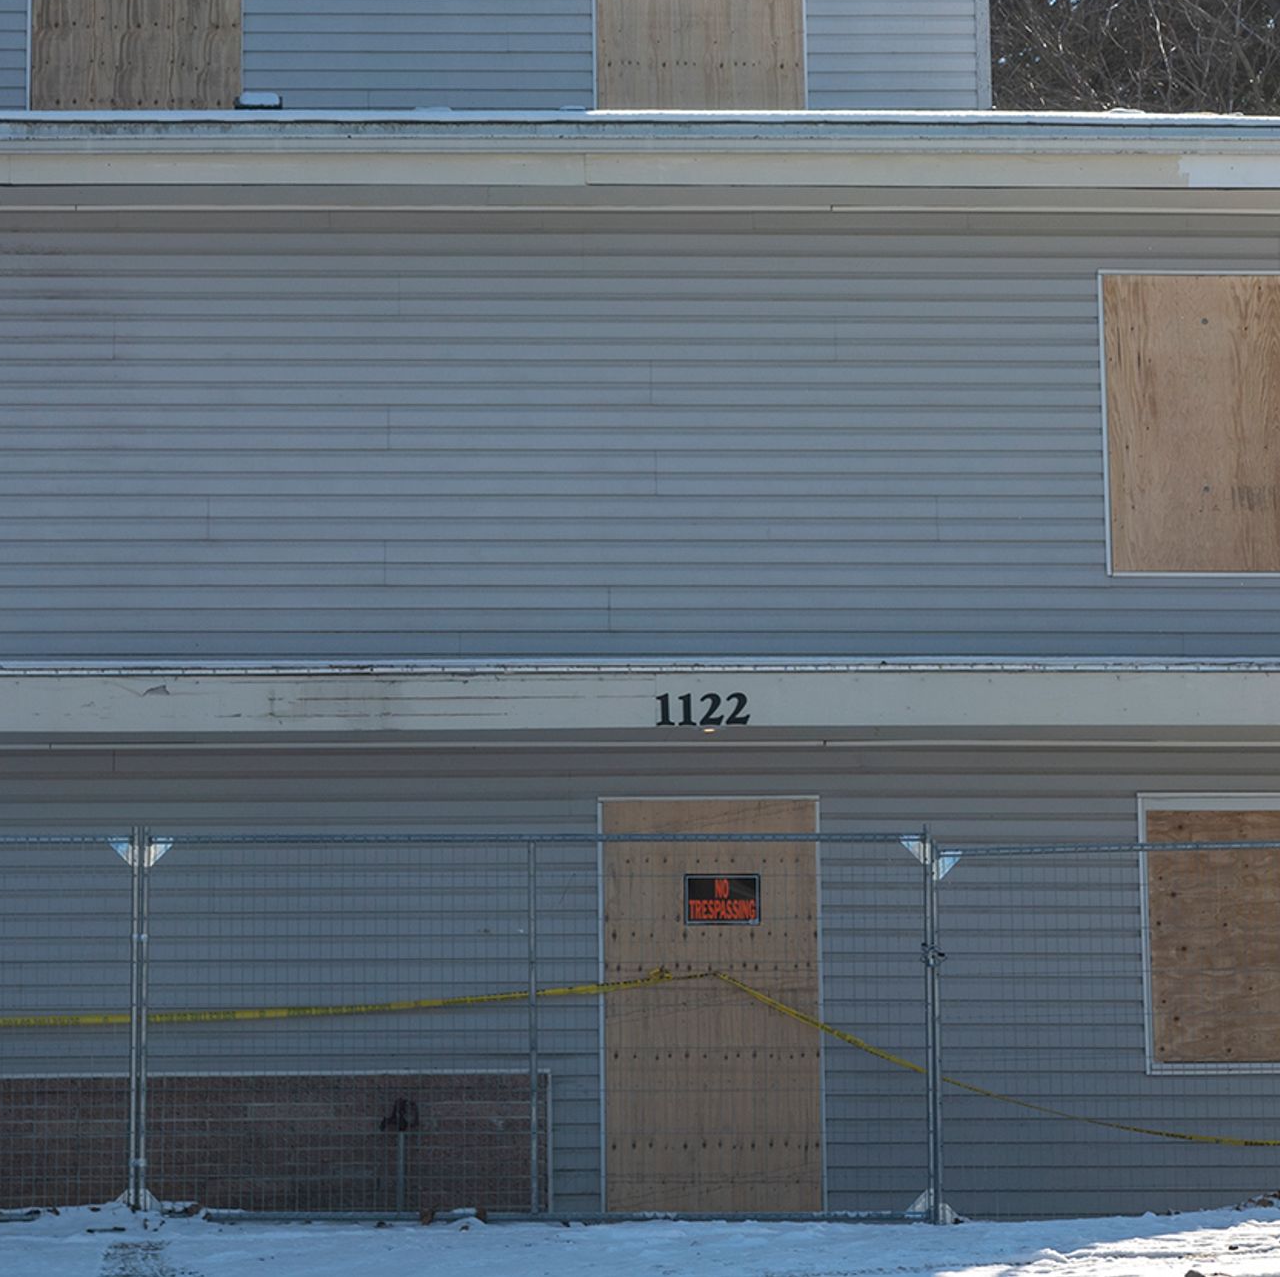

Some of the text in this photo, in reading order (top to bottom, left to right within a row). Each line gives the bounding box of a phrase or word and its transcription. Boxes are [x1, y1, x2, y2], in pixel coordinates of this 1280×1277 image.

[655, 692, 751, 726] 1122
[714, 879, 729, 899] NO
[688, 900, 757, 920] TRESPASSING
